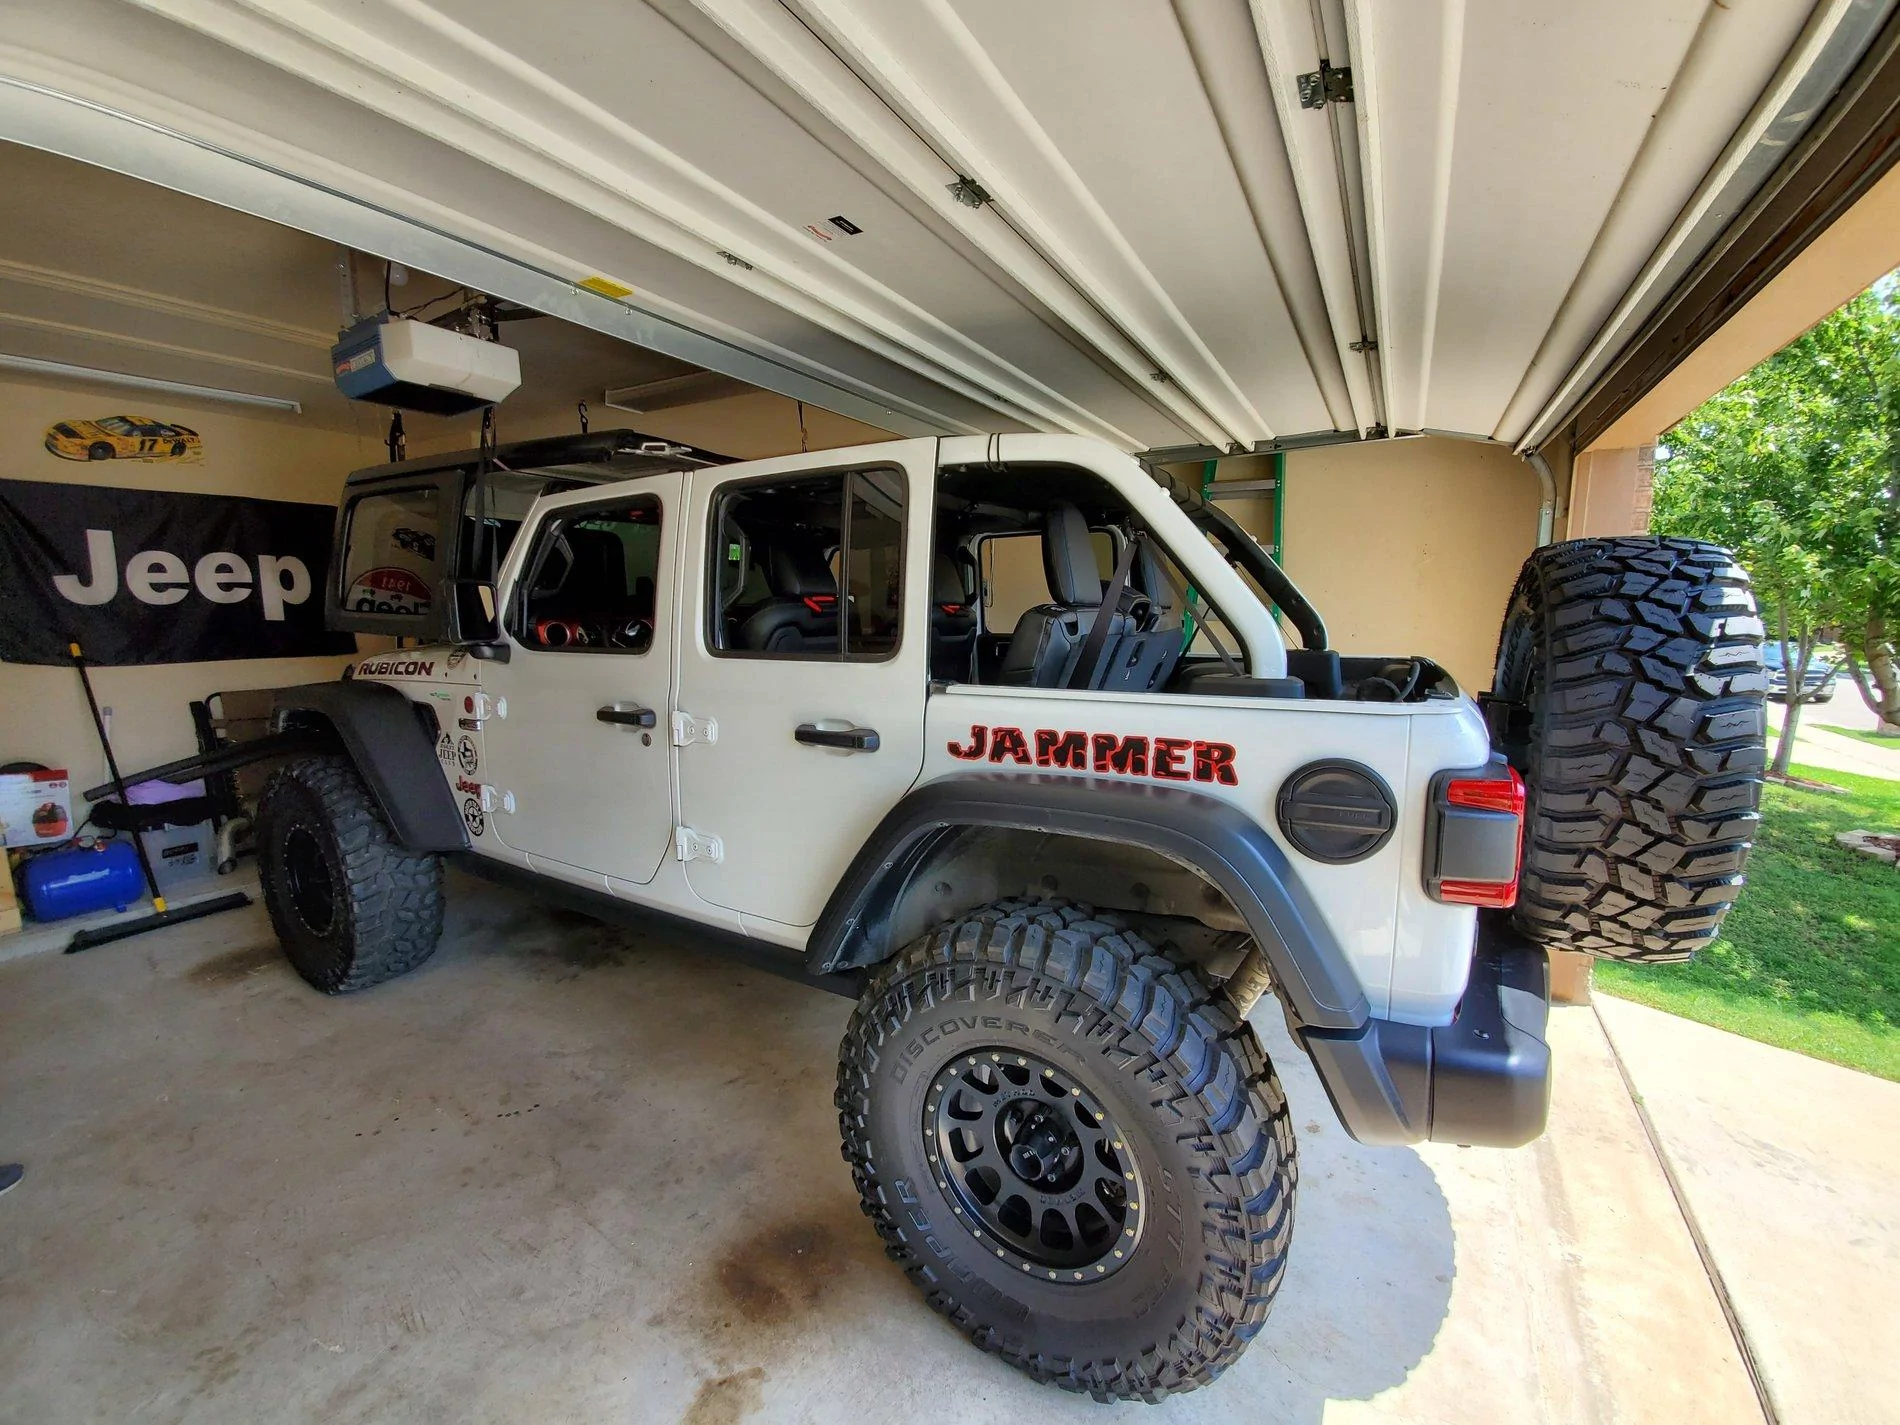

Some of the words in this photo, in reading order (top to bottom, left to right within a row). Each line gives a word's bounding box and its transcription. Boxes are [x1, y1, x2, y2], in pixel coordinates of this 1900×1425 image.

[139, 439, 158, 452] 17
[53, 529, 312, 621] Jeep
[358, 661, 435, 676] RUBICON
[947, 725, 1239, 786] JAMMER
[889, 1015, 1087, 1086] DISCOVERER
